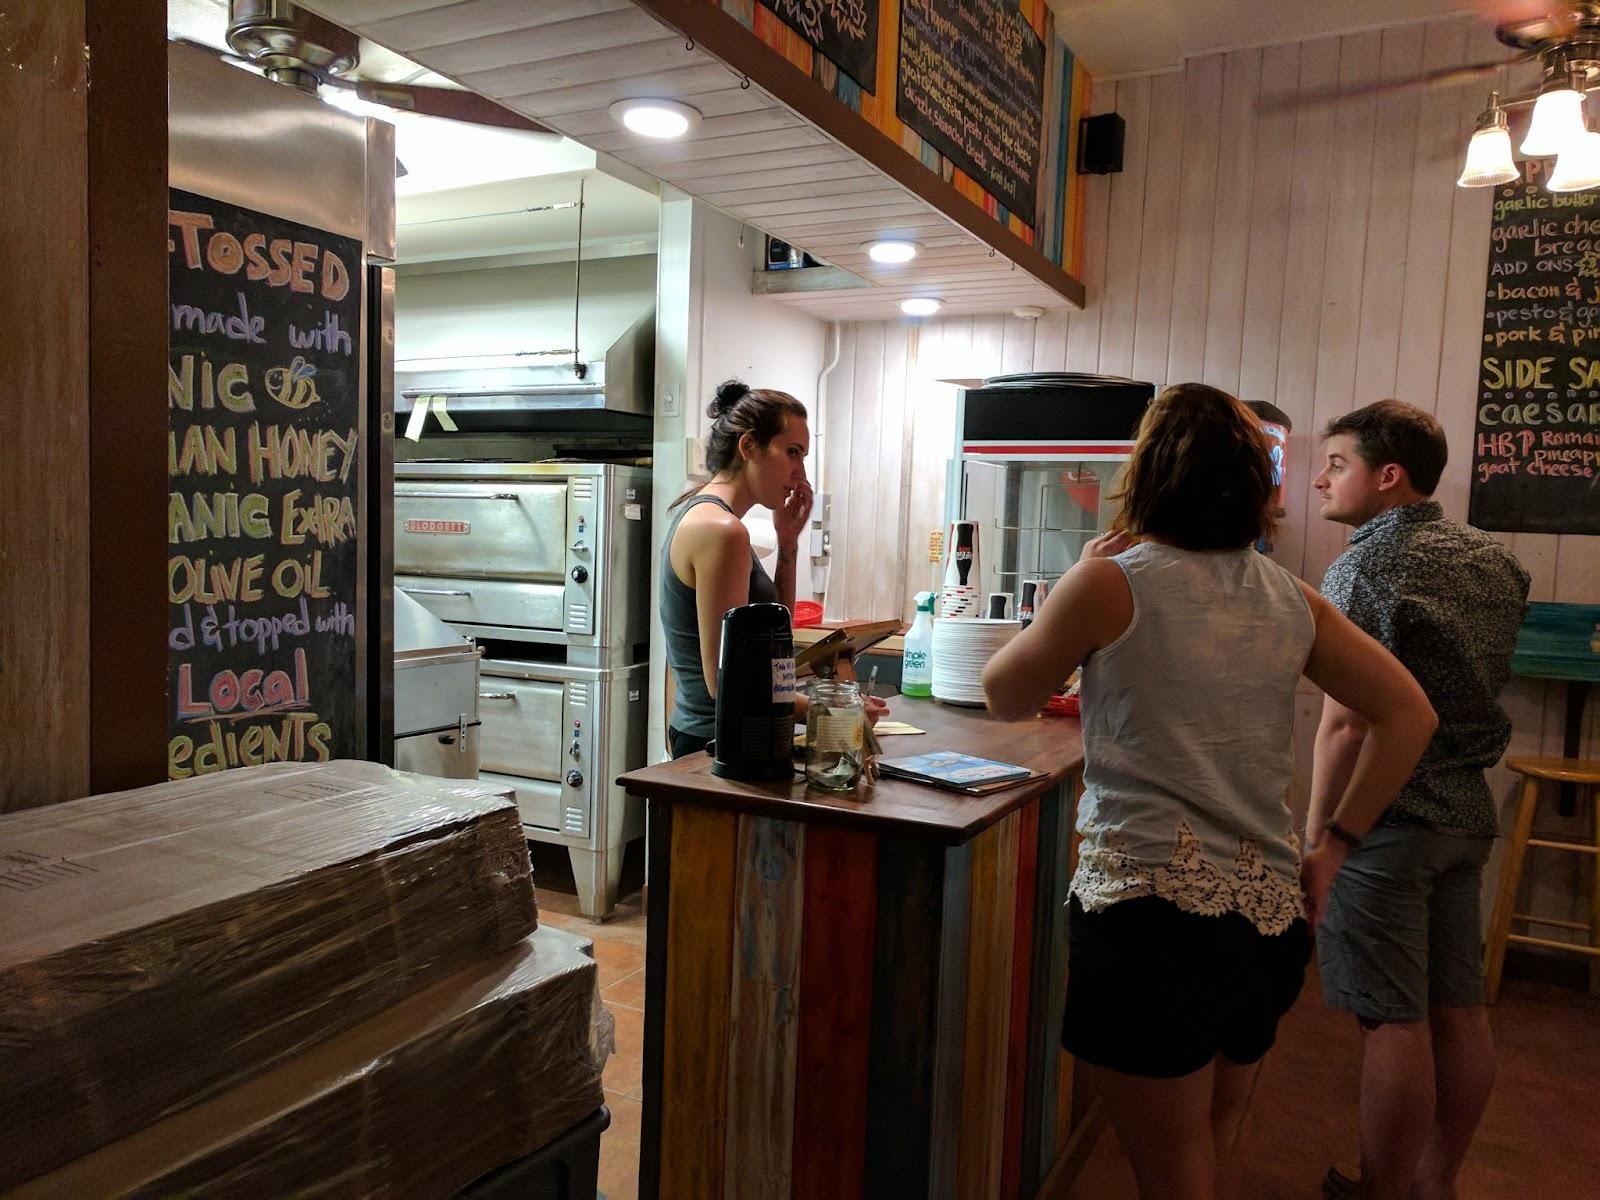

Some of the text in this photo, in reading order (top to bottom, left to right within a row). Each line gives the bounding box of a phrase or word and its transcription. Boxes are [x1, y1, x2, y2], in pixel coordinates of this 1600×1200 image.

[1494, 194, 1549, 221] garlic
[1493, 219, 1558, 253] garlic
[1492, 258, 1574, 276] ADD ONS
[1498, 282, 1560, 300] bacon
[172, 291, 352, 356] made with
[1496, 303, 1557, 327] pesto
[1496, 325, 1542, 348] pork
[1483, 356, 1556, 390] SIDE
[248, 420, 359, 486] HONEY
[1478, 429, 1536, 457] HBP
[1478, 456, 1593, 483] goat cheese
[410, 521, 462, 531] BLODGETT
[223, 597, 311, 656] topped
[315, 602, 355, 636] with
